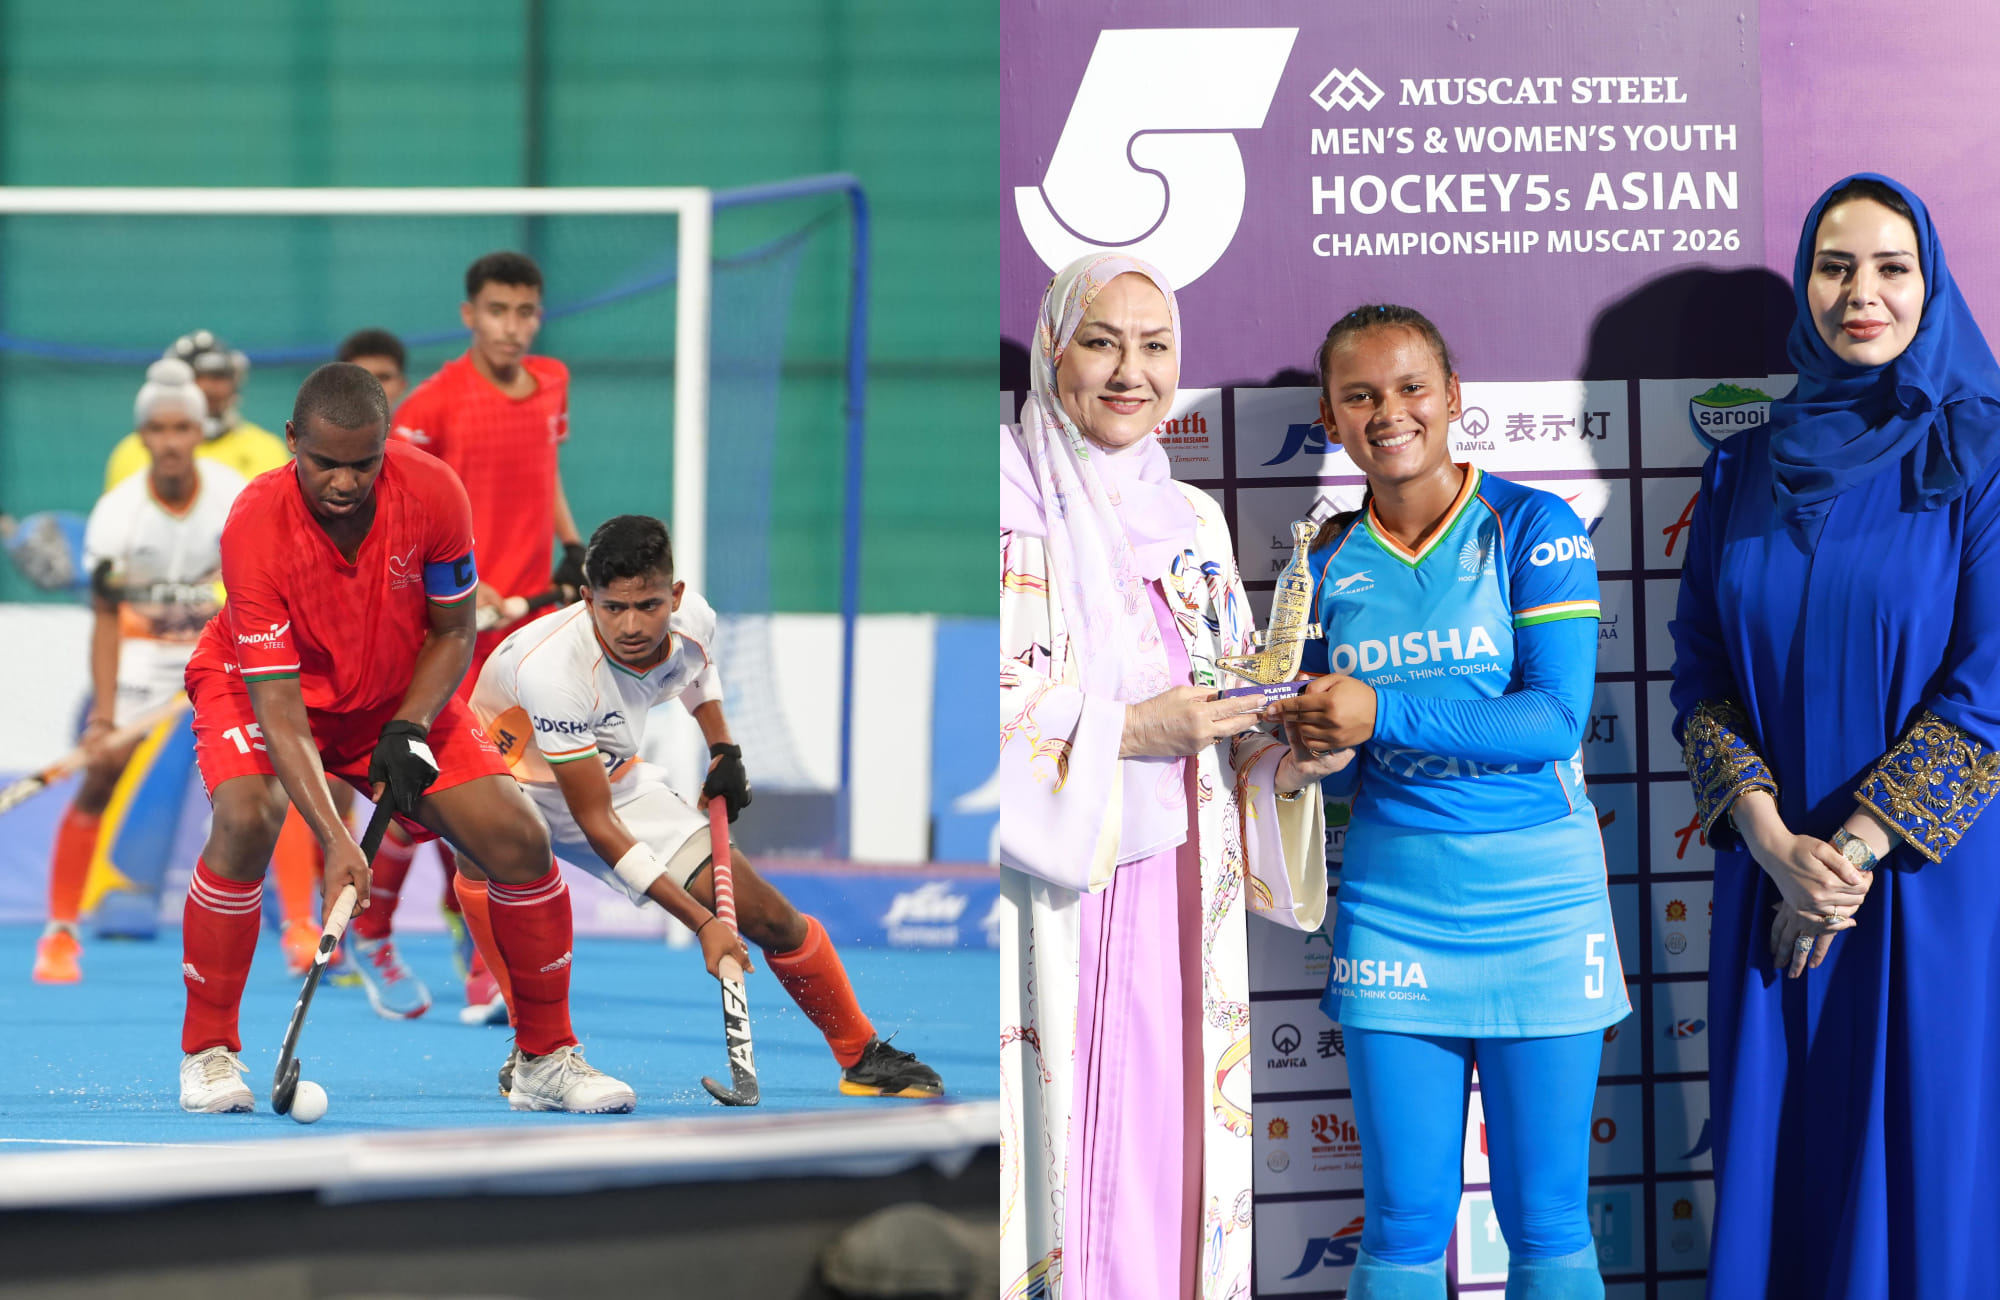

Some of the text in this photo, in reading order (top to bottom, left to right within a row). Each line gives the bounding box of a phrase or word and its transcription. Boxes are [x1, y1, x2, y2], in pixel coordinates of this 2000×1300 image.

[1398, 76, 1688, 106] MUSCAT STEEL
[1311, 124, 1737, 155] MEN’S & WOMEN’S YOUTH
[1311, 171, 1738, 215] HOCKEY5s ASIAN
[1312, 229, 1740, 257] CHAMPIONSHIP MUSCAT 2026
[1504, 411, 1611, 442] 表示灯
[1530, 535, 1596, 567] ODISH
[453, 559, 474, 588] C
[1331, 626, 1500, 676] ODISHA
[1408, 667, 1447, 681] THINK
[1263, 686, 1292, 695] PLAYER
[1584, 933, 1605, 999] 5
